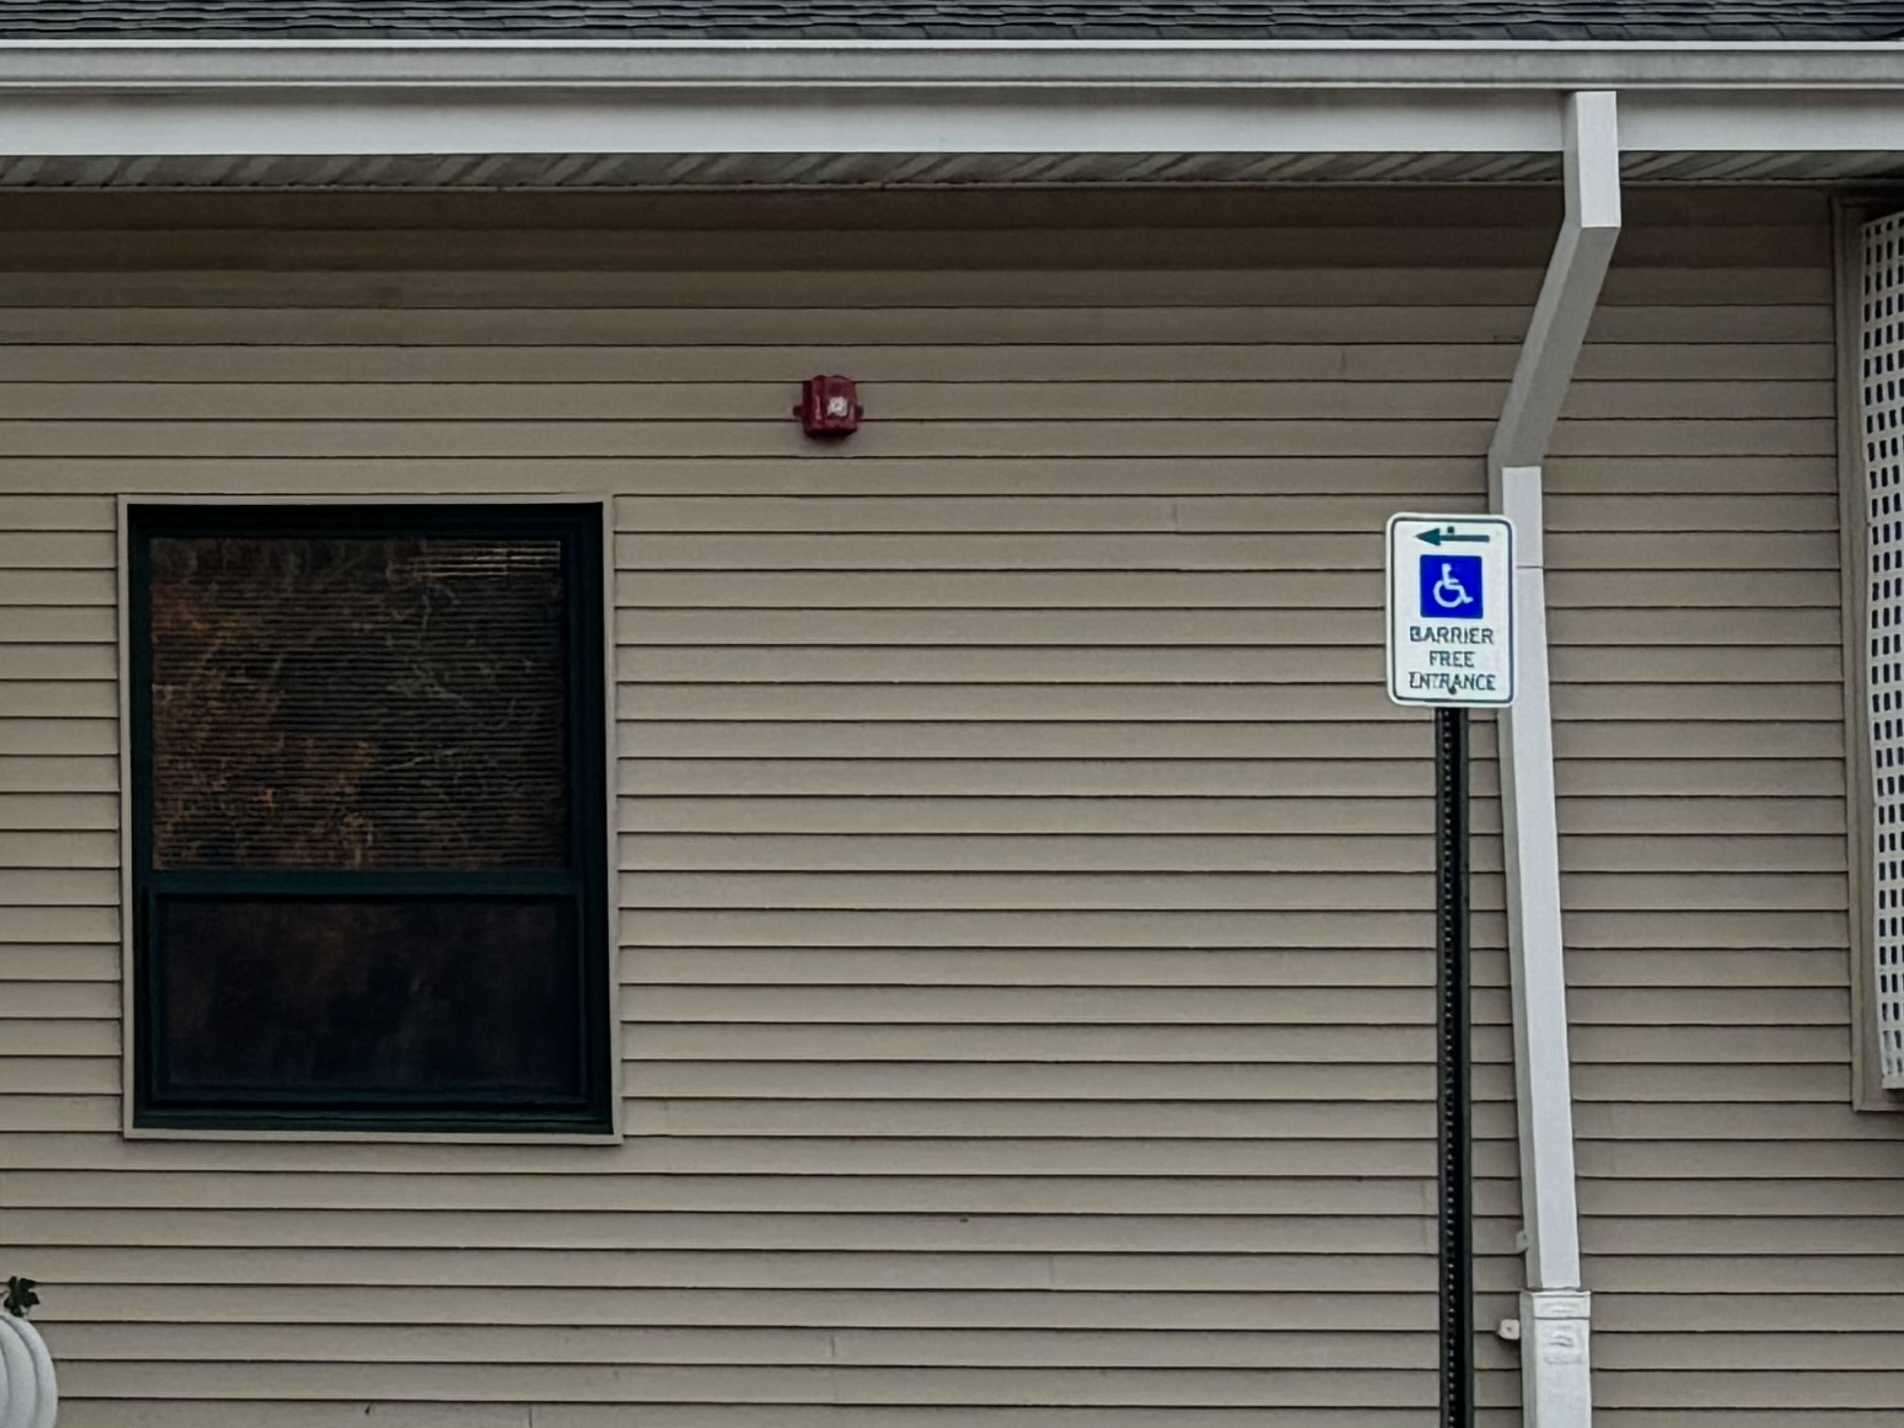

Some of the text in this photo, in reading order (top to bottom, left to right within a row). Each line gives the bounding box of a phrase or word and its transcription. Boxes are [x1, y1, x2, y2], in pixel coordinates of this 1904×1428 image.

[1409, 626, 1495, 645] BARRIER
[1429, 650, 1476, 669] FREE
[1408, 671, 1497, 691] ENTRANCE
